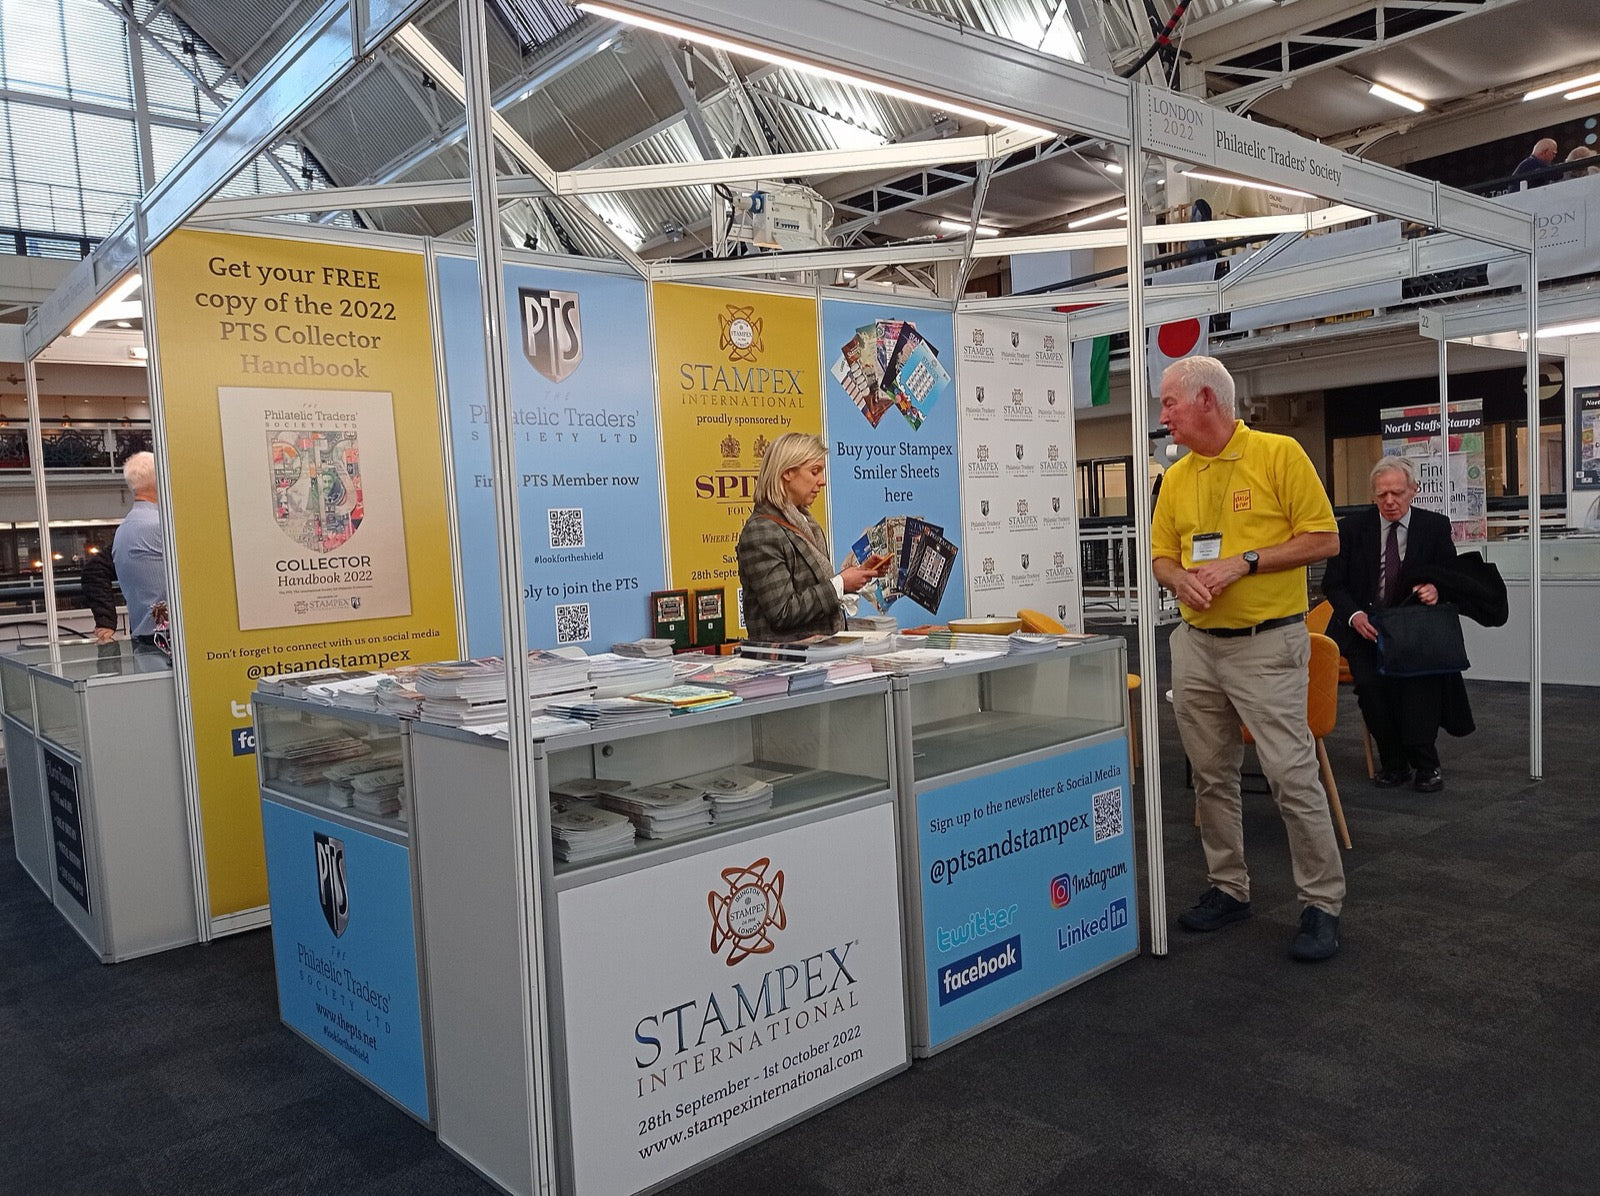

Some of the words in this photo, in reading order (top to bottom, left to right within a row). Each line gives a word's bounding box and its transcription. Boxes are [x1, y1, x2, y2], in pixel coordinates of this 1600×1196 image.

[1152, 97, 1204, 127] LONDON
[1164, 119, 1194, 141] 2022
[1216, 130, 1266, 160] Philatelic
[1268, 146, 1307, 172] Traders'
[1310, 160, 1342, 187] Society
[1537, 211, 1576, 228] DON
[1539, 227, 1560, 240] 22
[208, 257, 251, 278] Get
[257, 266, 315, 286] your
[322, 267, 380, 289] FREE
[196, 292, 257, 316] copy
[264, 292, 289, 312] of
[295, 294, 333, 316] the
[340, 300, 396, 320] 2022
[1422, 315, 1429, 328] 22
[220, 322, 267, 342] PTS
[275, 325, 381, 349] Collector
[523, 296, 579, 376] PTS
[964, 346, 994, 356] STAMPEX
[1036, 352, 1063, 361] STAMPEX
[240, 354, 369, 378] Handbook
[680, 363, 804, 395] STAMPEX
[682, 394, 804, 409] INTERNATIONAL
[1004, 406, 1033, 415] STAMPEX
[264, 410, 312, 421] Philatelic
[315, 411, 358, 421] Traders'
[564, 408, 639, 428] Traders'
[697, 414, 733, 426] proudly
[735, 415, 779, 425] sponsored
[781, 416, 791, 428] by
[1384, 423, 1412, 434] North
[1414, 420, 1441, 433] Staffs
[600, 433, 638, 444] LTD
[837, 442, 864, 460] Buy
[865, 444, 896, 460] your
[899, 442, 953, 460] Stampex
[854, 464, 897, 480] Smiler
[901, 465, 940, 479] Sheets
[968, 463, 999, 472] STAMPEX
[1040, 462, 1068, 470] STAMPEX
[523, 475, 549, 487] PTS
[552, 473, 608, 487] Member
[612, 476, 640, 486] now
[696, 475, 758, 499] SPI
[885, 487, 913, 502] here
[1009, 516, 1038, 525] STAMPEX
[276, 556, 371, 572] COLLECTOR
[534, 552, 604, 564] #lookfortheshield
[278, 574, 341, 587] Handbook
[344, 571, 372, 582] 2022
[692, 569, 711, 580] 28th
[714, 569, 737, 581] Septe
[974, 574, 1005, 585] STAMPEX
[1046, 568, 1074, 578] STAMPEX
[547, 584, 559, 596] to
[563, 582, 588, 599] join
[592, 579, 612, 593] the
[616, 577, 639, 590] PTS
[207, 649, 236, 661] Don't
[239, 646, 270, 658] forget
[273, 645, 283, 654] to
[286, 641, 327, 652] connect
[330, 637, 352, 649] with
[354, 637, 366, 645] us
[368, 635, 380, 644] on
[383, 632, 409, 642] social
[412, 629, 440, 639] media
[247, 650, 411, 680] @ptsandstampex
[930, 816, 954, 834] Sign
[956, 812, 971, 828] up
[974, 808, 984, 820] to
[986, 802, 1003, 816] the
[1005, 786, 1055, 810] newsletter
[1057, 782, 1064, 794] &
[1066, 773, 1093, 791] Social
[1095, 765, 1121, 782] Media
[930, 812, 1090, 885] @ptsandstampex
[316, 839, 348, 931] PTS
[1073, 862, 1127, 895] Instagram
[730, 903, 766, 921] STAMPEX
[738, 921, 761, 934] LONDON
[937, 904, 1018, 952] twitter
[297, 942, 343, 988] Philatelic
[344, 969, 390, 1015] Traders'
[943, 944, 1017, 994] facebook
[300, 970, 354, 1012] SOCIETY
[366, 1008, 391, 1034] LTD
[635, 941, 858, 1069] STAMPEX
[316, 1002, 377, 1050] www.thepts.net
[637, 992, 858, 1098] INTERNATIONAL
[639, 1110, 671, 1136] 28th
[676, 1077, 750, 1119] September
[763, 1062, 779, 1081] 1st
[782, 1041, 829, 1070] October
[833, 1026, 861, 1049] 2022
[638, 1048, 863, 1160] www.stampexinternational.com
